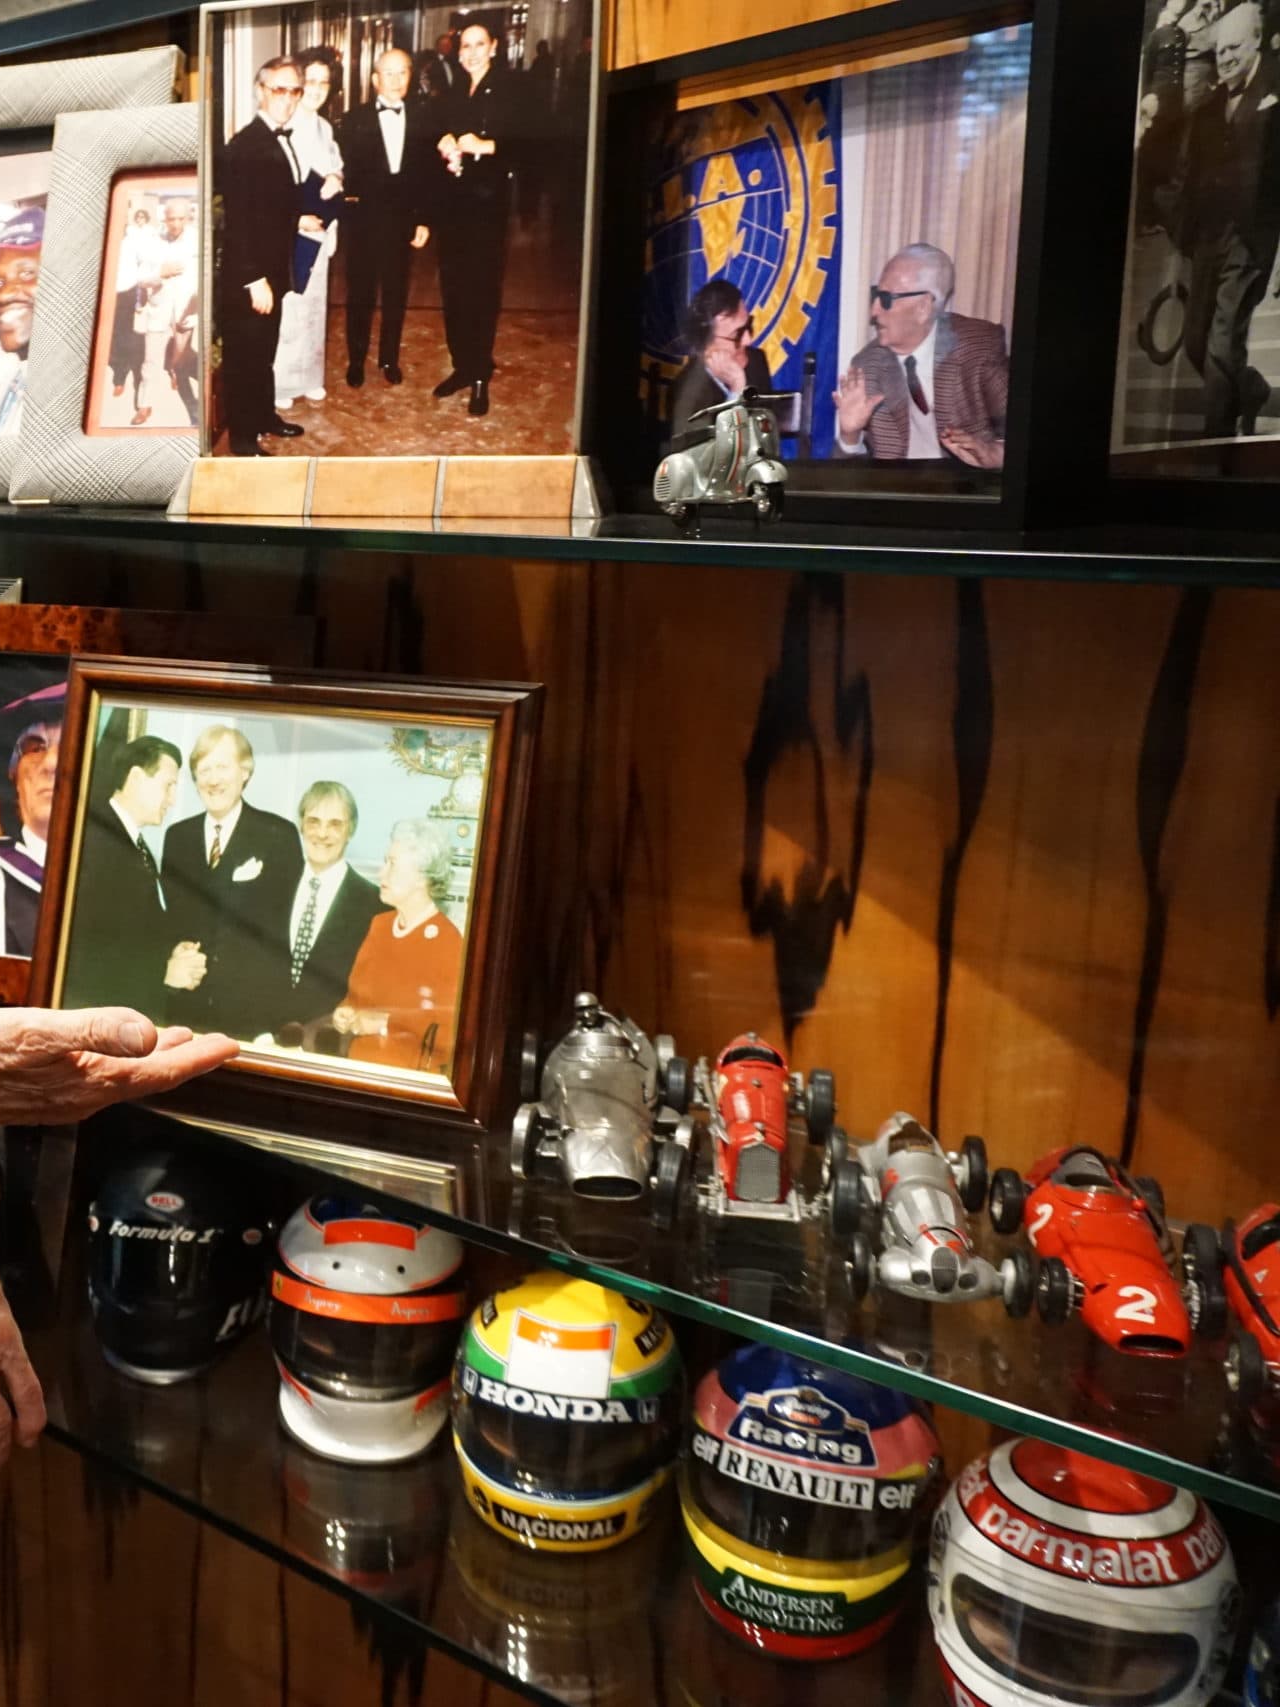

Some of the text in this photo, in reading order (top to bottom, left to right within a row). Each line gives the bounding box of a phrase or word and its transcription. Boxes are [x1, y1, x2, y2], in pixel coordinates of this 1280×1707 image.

[109, 1219, 216, 1243] Formula 1
[1114, 1285, 1158, 1325] 2
[479, 1377, 632, 1423] HONDA
[738, 1417, 862, 1464] Racing
[692, 1433, 918, 1509] elf RENAULT elf
[500, 1508, 616, 1541] NACIONAL
[977, 1504, 1179, 1583] parmalat
[721, 1587, 845, 1632] CONSULTING
[729, 1574, 836, 1616] ANDERSEN
